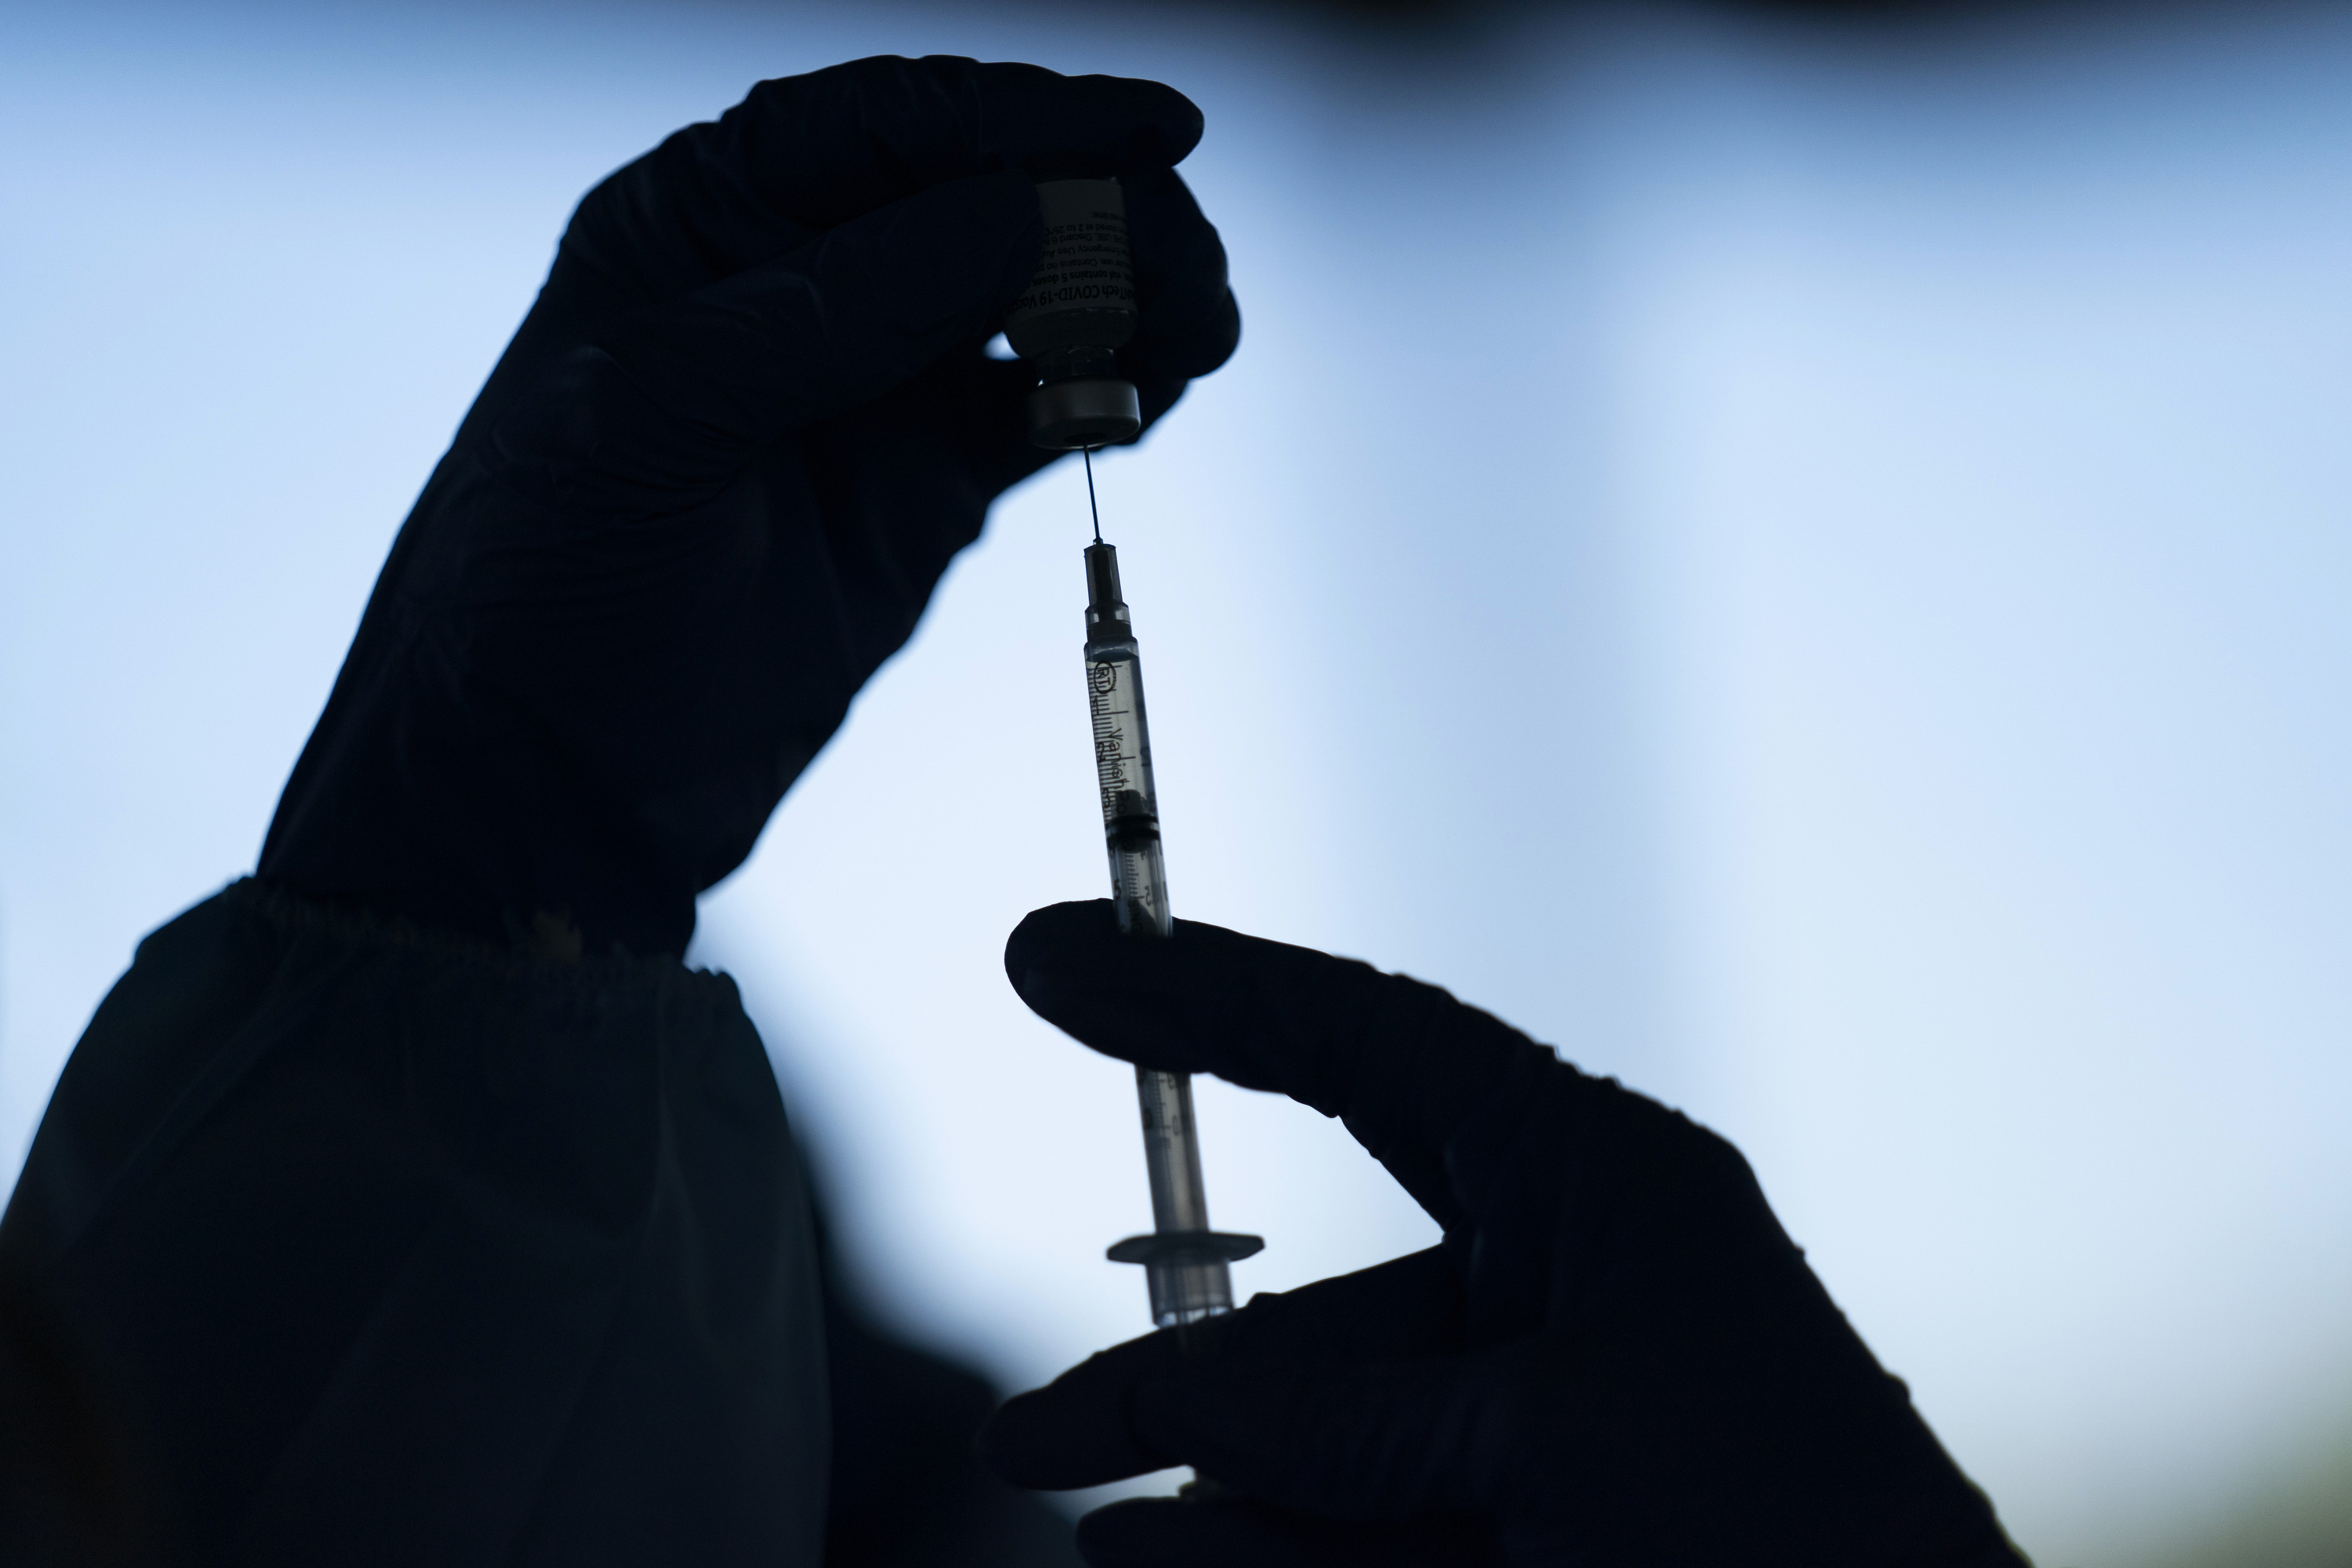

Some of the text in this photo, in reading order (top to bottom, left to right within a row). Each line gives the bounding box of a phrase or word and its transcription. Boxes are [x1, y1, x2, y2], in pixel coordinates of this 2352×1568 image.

[1060, 233, 1091, 243] Discard
[1058, 246, 1075, 255] Use
[1078, 245, 1120, 254] Emergency
[1033, 274, 1058, 286] doses
[1062, 273, 1068, 282] 5
[1070, 270, 1107, 281] contains
[1040, 285, 1099, 307] COVID-19
[1107, 727, 1130, 815] VanishPo
[1127, 899, 1144, 934] SING
